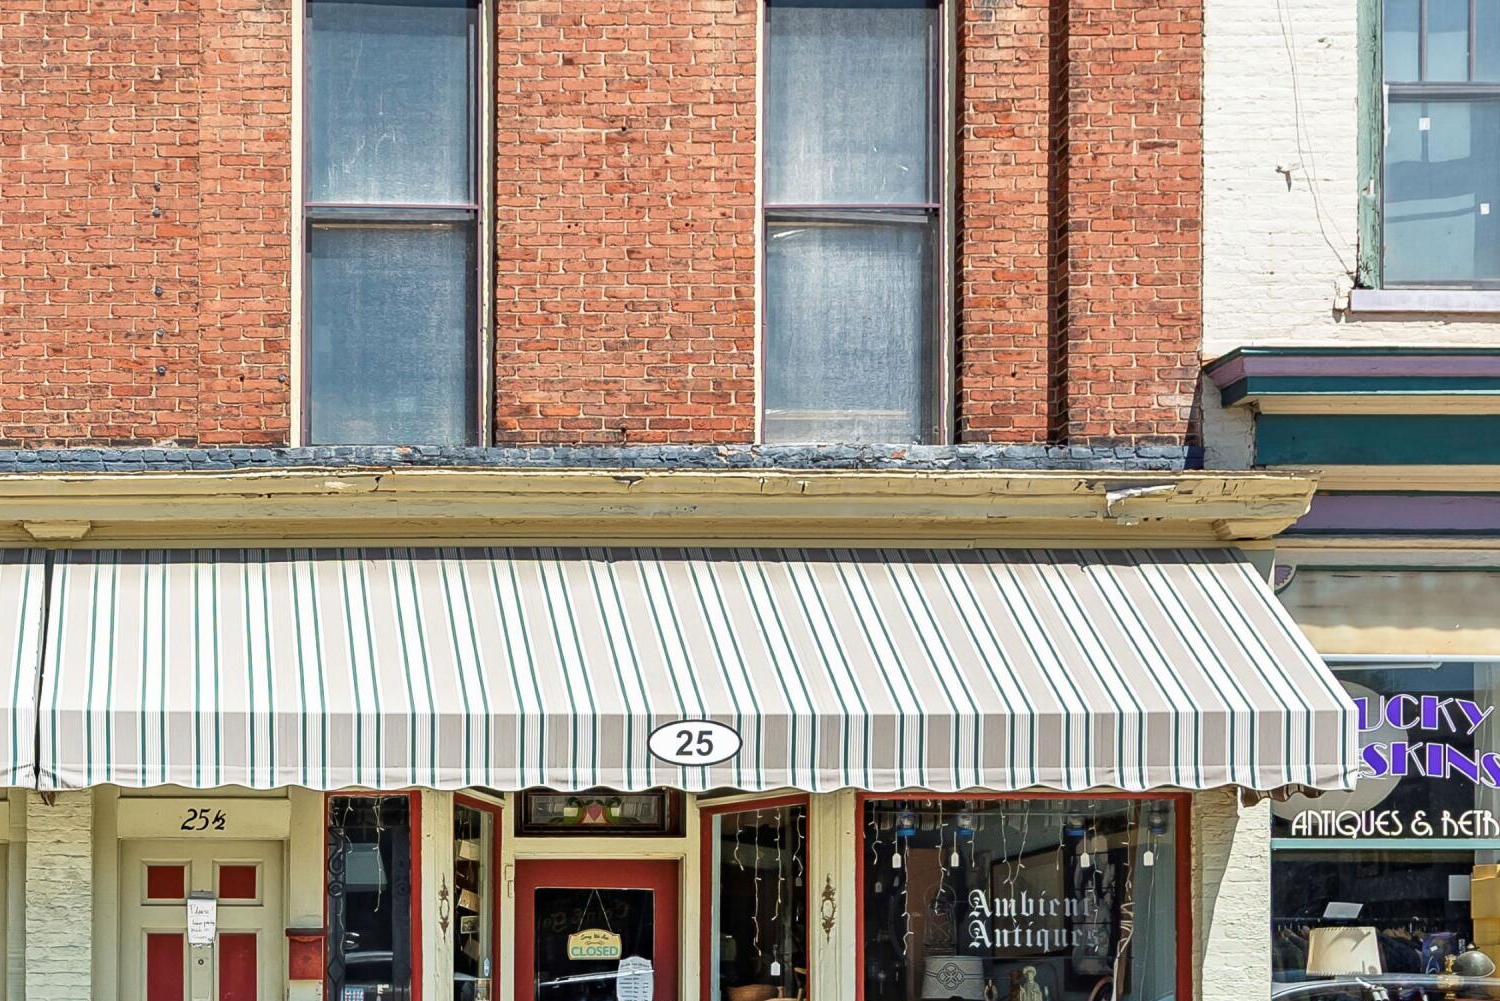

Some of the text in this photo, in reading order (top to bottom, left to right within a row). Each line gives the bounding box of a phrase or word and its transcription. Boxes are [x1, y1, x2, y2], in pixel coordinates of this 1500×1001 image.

[1352, 693, 1495, 735] UCKY
[676, 729, 714, 756] 25
[1291, 810, 1500, 839] ANTIQUES & RETR
[968, 888, 1092, 918] Ambient
[570, 946, 619, 956] CLOSED
[968, 919, 1100, 954] Antiques
